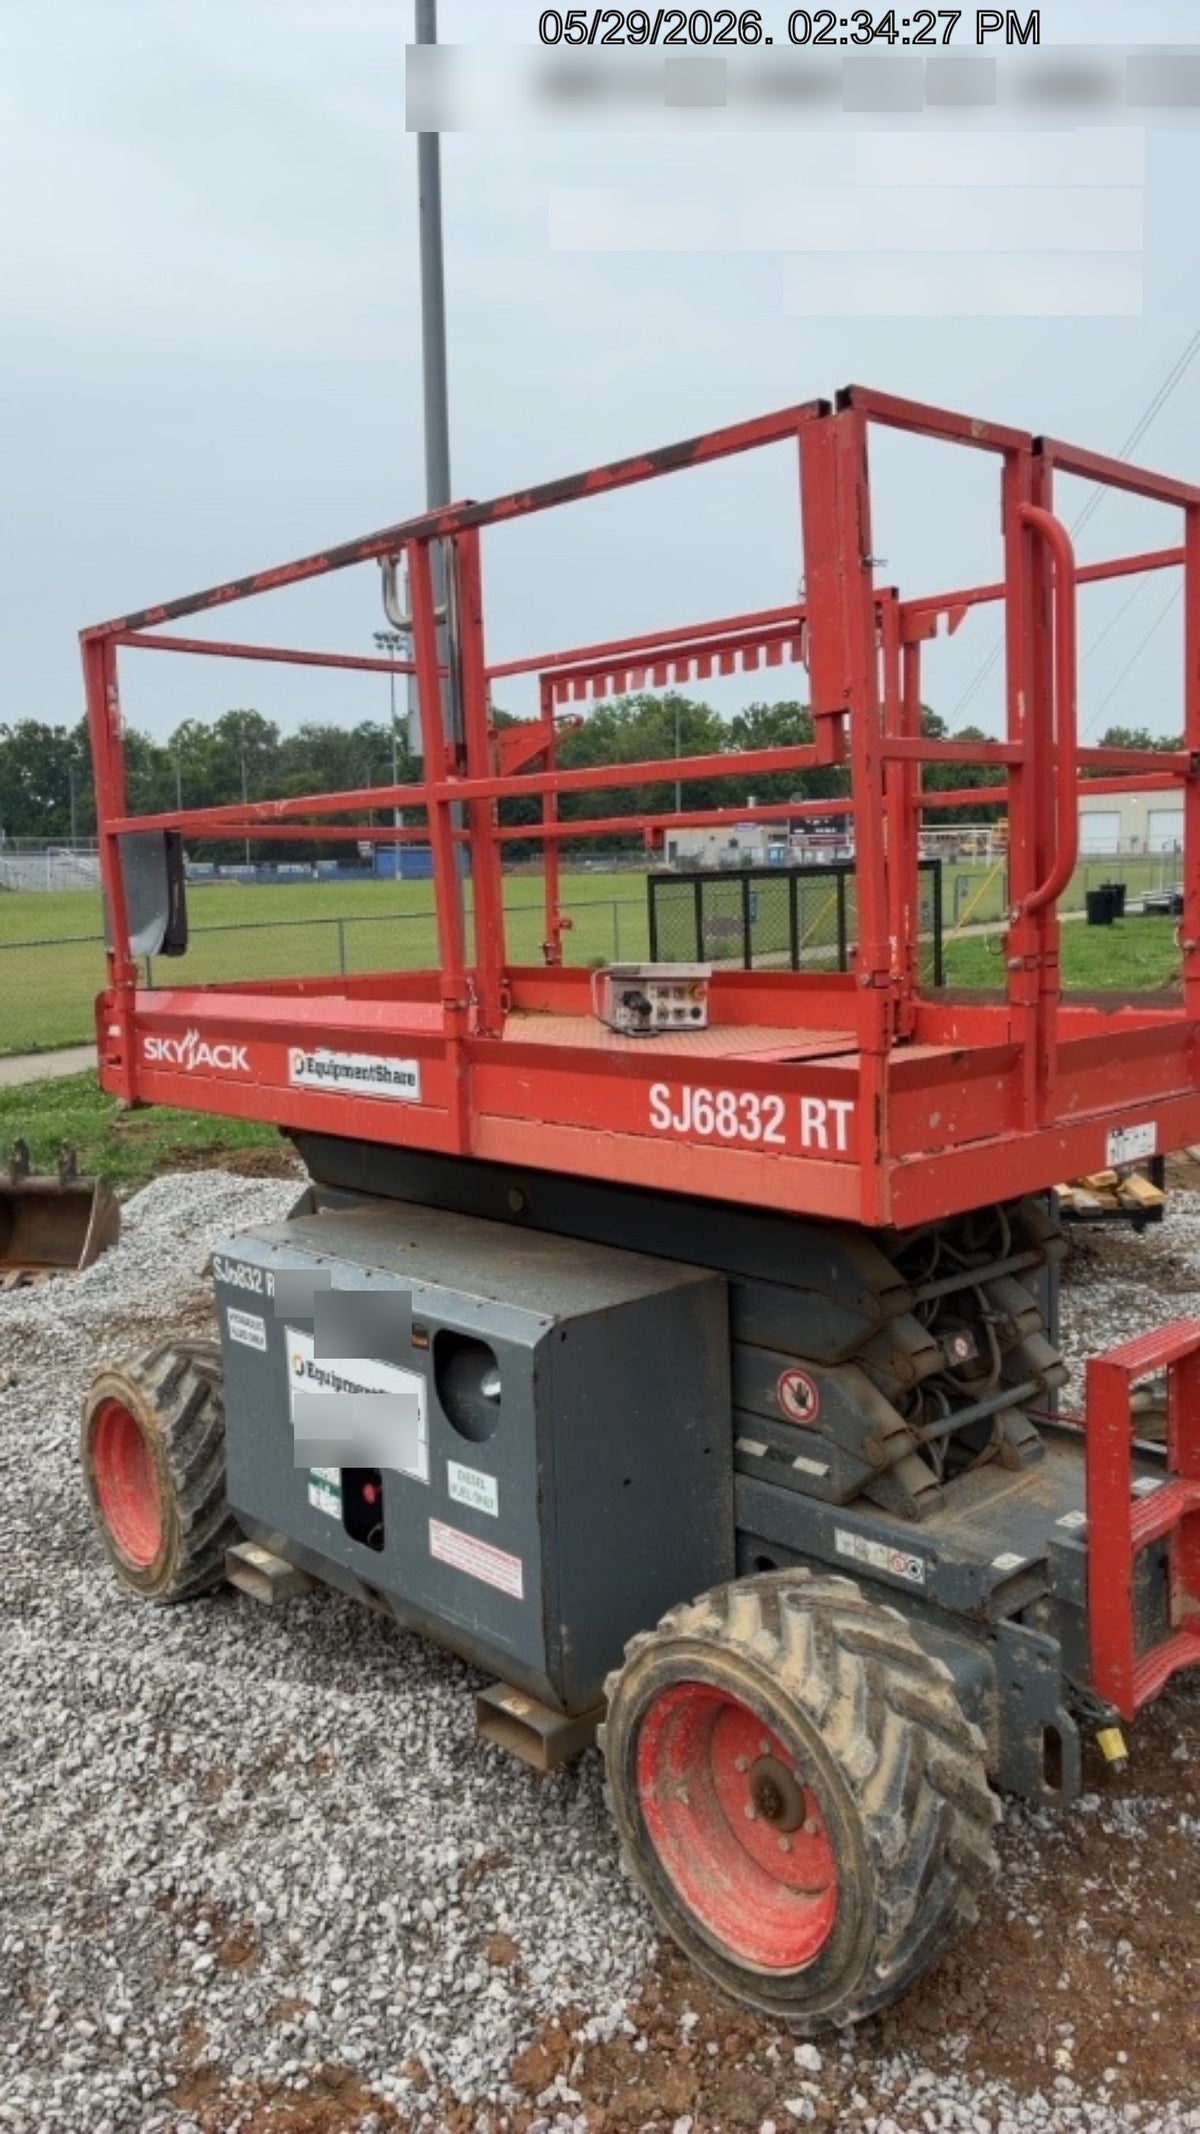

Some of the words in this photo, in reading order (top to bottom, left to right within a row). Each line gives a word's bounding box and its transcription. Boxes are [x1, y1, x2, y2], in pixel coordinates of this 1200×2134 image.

[143, 1028, 250, 1071] SKYJACK
[306, 1056, 416, 1088] EquipmentShare
[649, 1082, 787, 1144] SJ6832
[800, 1097, 855, 1151] RT
[265, 1271, 276, 1299] R
